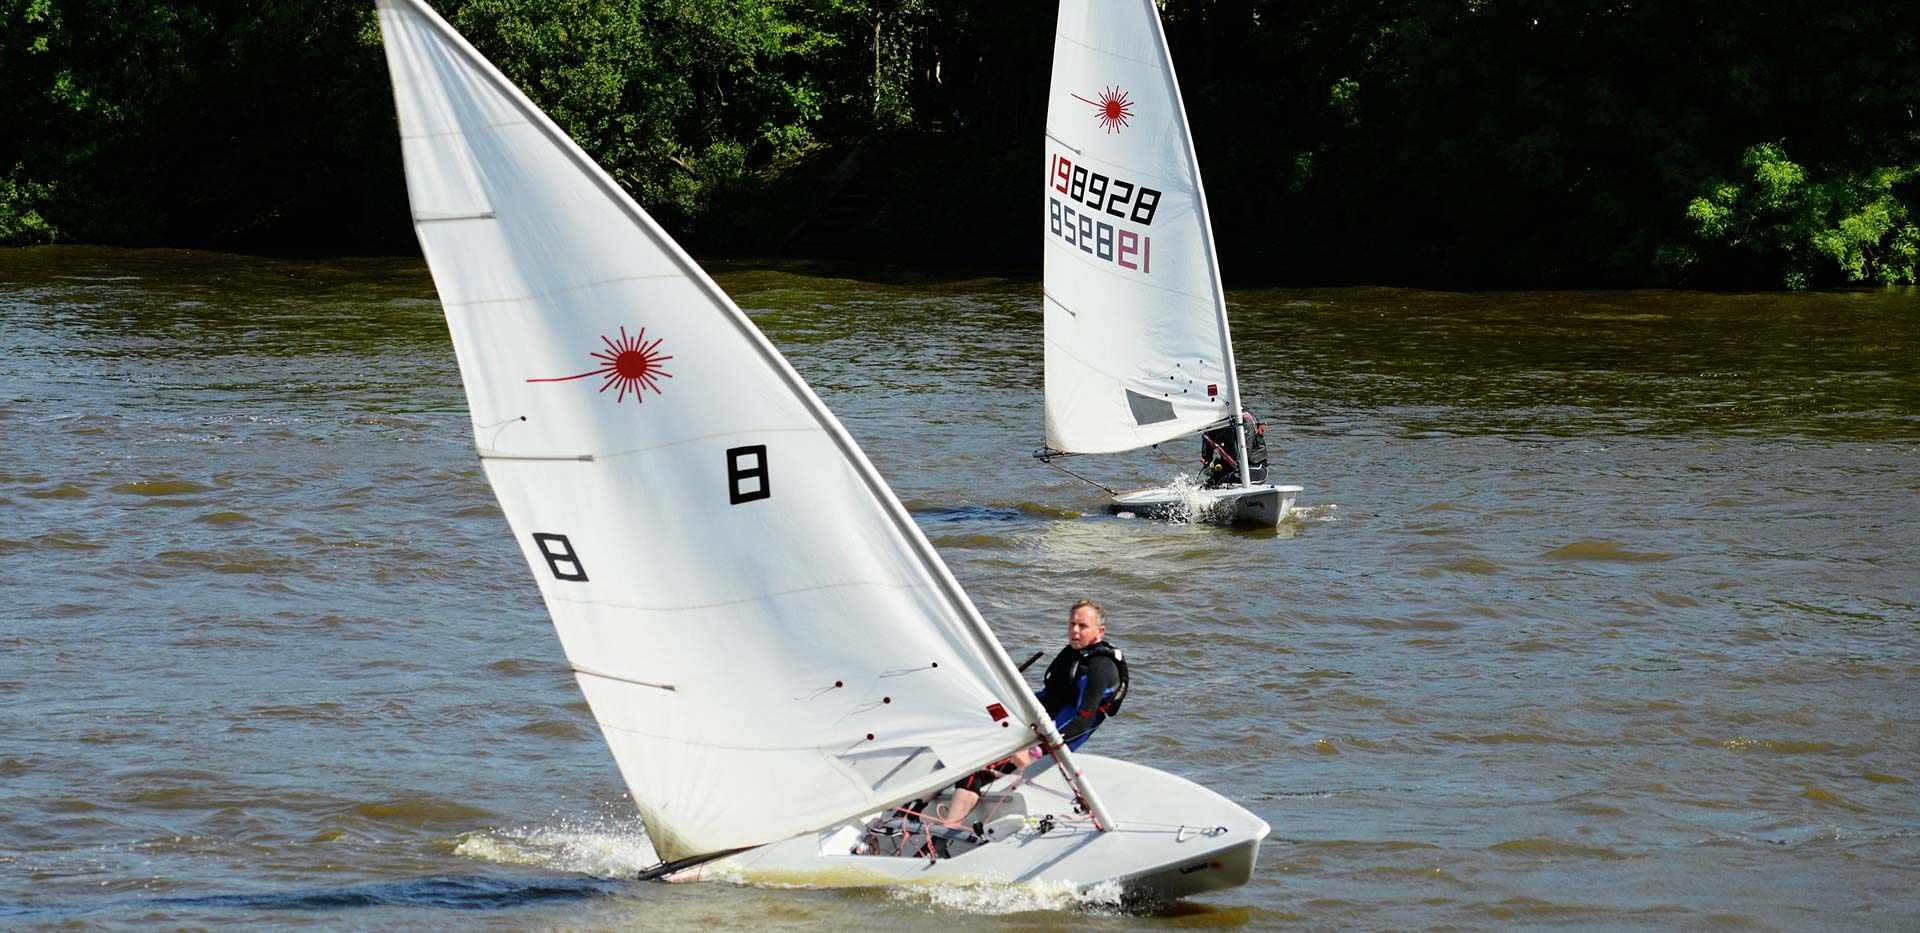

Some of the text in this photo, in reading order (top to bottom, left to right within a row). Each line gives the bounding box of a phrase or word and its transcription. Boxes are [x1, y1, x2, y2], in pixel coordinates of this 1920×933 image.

[1050, 154, 1161, 226] 198928
[726, 444, 770, 505] 8
[532, 533, 589, 582] 8
